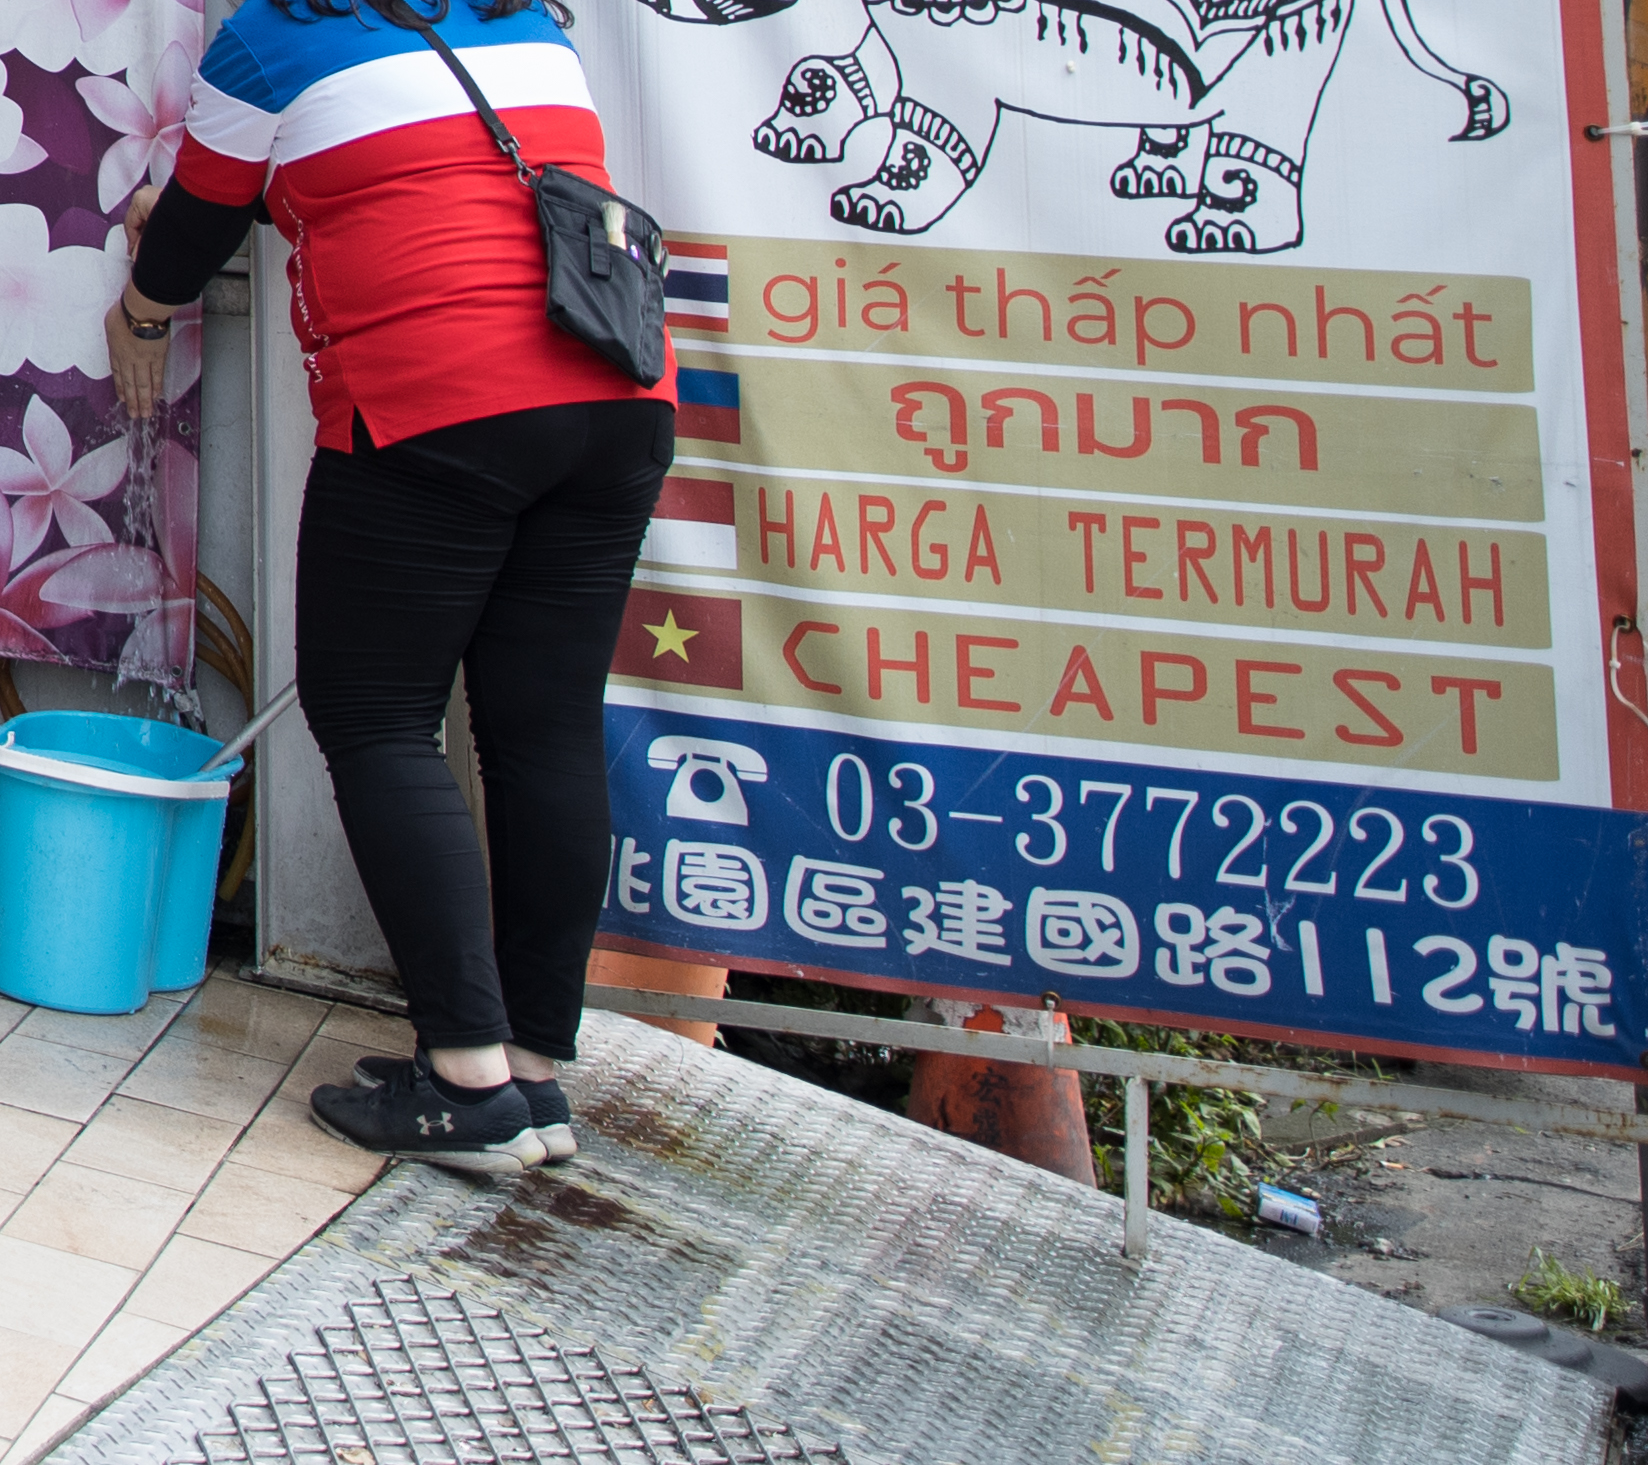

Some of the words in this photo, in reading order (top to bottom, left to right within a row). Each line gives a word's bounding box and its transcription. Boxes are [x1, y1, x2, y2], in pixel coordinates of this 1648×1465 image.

[762, 257, 911, 346] giá
[944, 267, 1197, 366] thấp
[1238, 283, 1500, 370] nhất
[890, 378, 1321, 474] ถูกมาก
[758, 485, 1003, 586] HARGA
[1068, 510, 1506, 628] TERMURAH
[783, 620, 1502, 756] CHEAPEST
[824, 750, 1480, 910] 03-3772223
